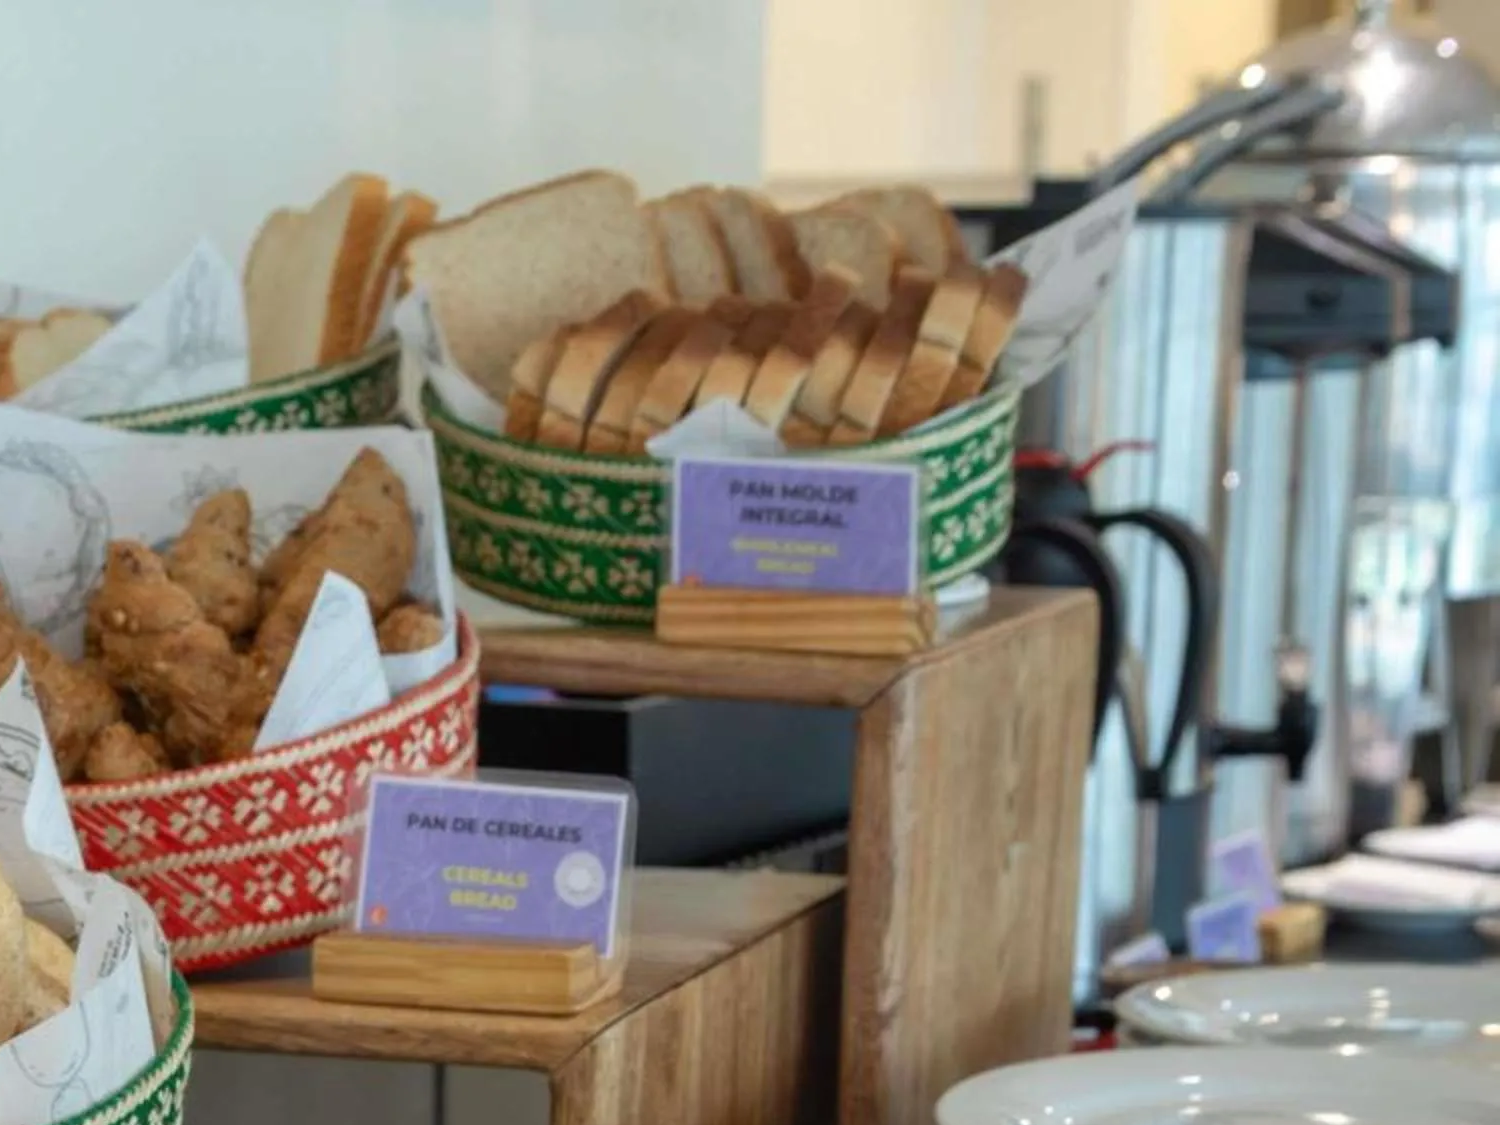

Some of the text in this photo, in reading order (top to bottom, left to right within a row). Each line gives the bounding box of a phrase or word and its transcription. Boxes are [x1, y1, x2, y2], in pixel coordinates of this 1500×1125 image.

[729, 480, 858, 504] PAN MOLDE
[739, 506, 847, 529] INTEGRAL
[407, 812, 583, 844] PAN DE CEREALES
